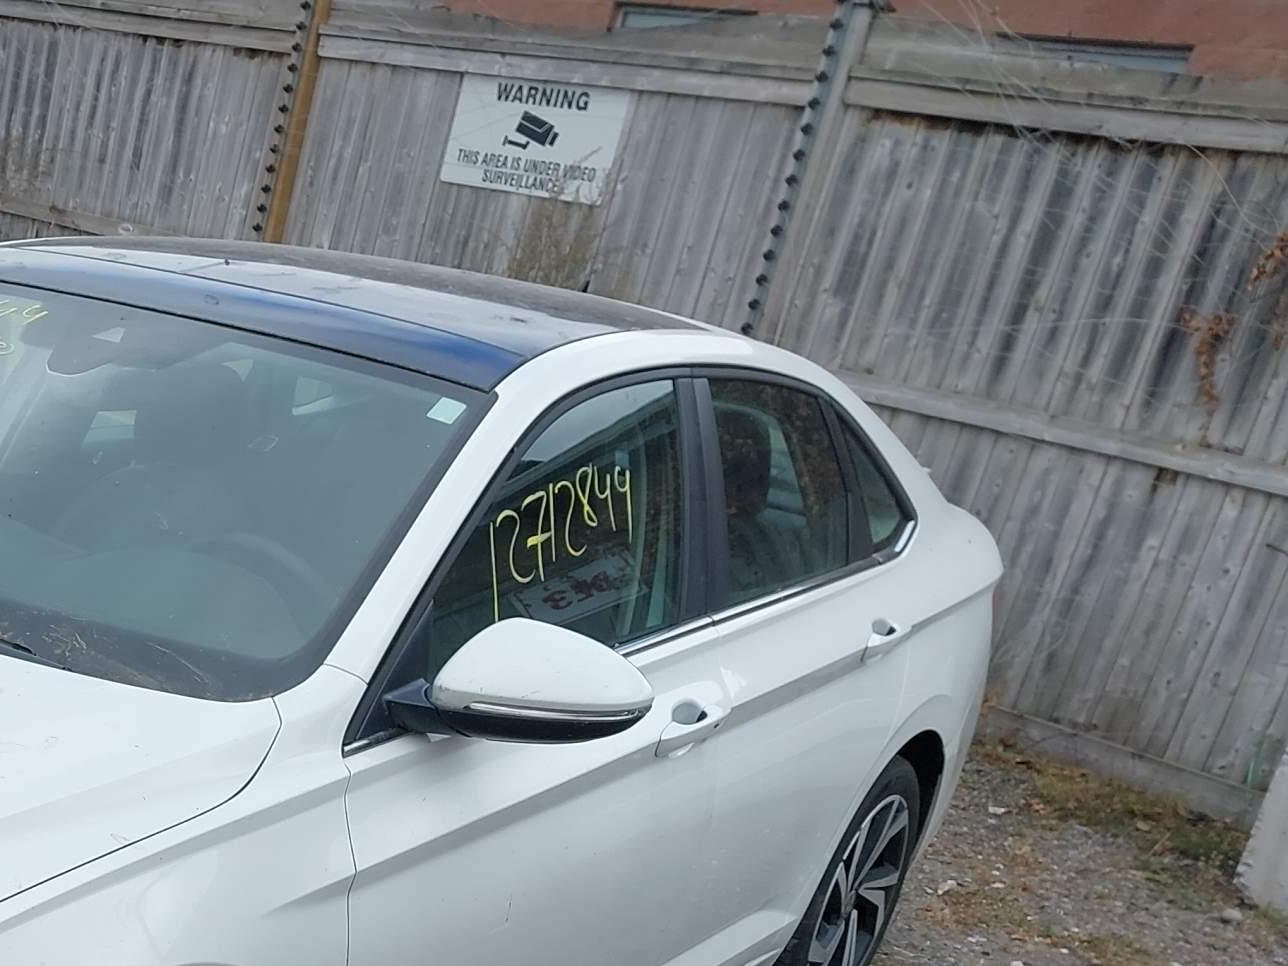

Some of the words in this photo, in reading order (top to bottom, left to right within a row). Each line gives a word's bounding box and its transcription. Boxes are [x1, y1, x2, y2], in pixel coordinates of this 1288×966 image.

[497, 82, 590, 111] WARNING
[457, 149, 480, 165] THIS
[481, 151, 509, 169] AREA
[510, 156, 523, 172] IS
[524, 159, 560, 177] UNDER
[562, 164, 596, 183] VIDEO
[482, 169, 561, 193] SURVEILLANCE
[490, 463, 633, 623] 12712844
